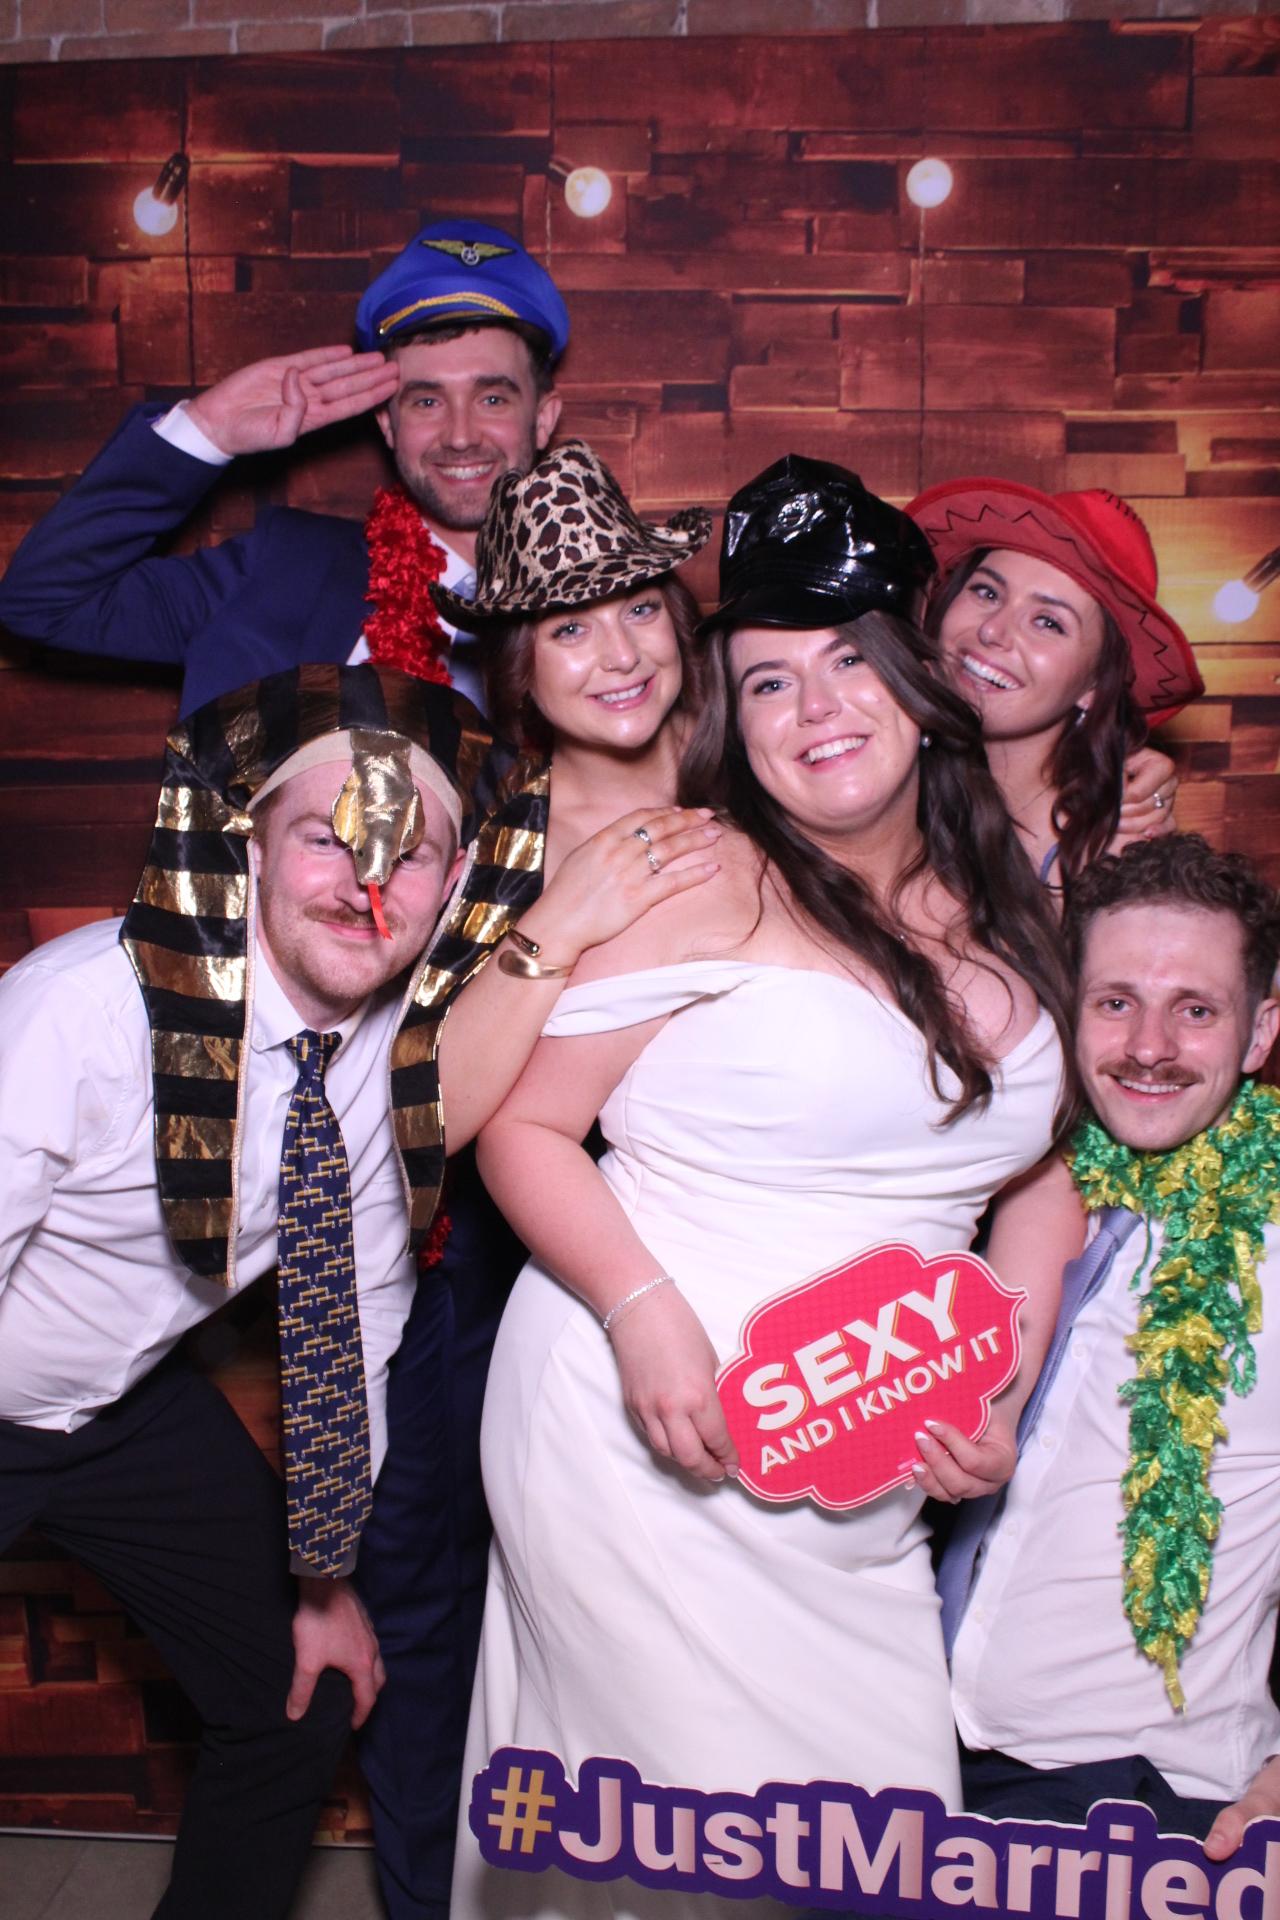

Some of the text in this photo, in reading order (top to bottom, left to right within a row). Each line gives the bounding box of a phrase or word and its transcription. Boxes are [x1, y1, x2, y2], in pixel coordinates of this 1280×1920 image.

[742, 1269, 960, 1431] SEXY
[760, 1325, 1003, 1476] AND I KNOW IT
[487, 1767, 1280, 1920] #JustMarried
